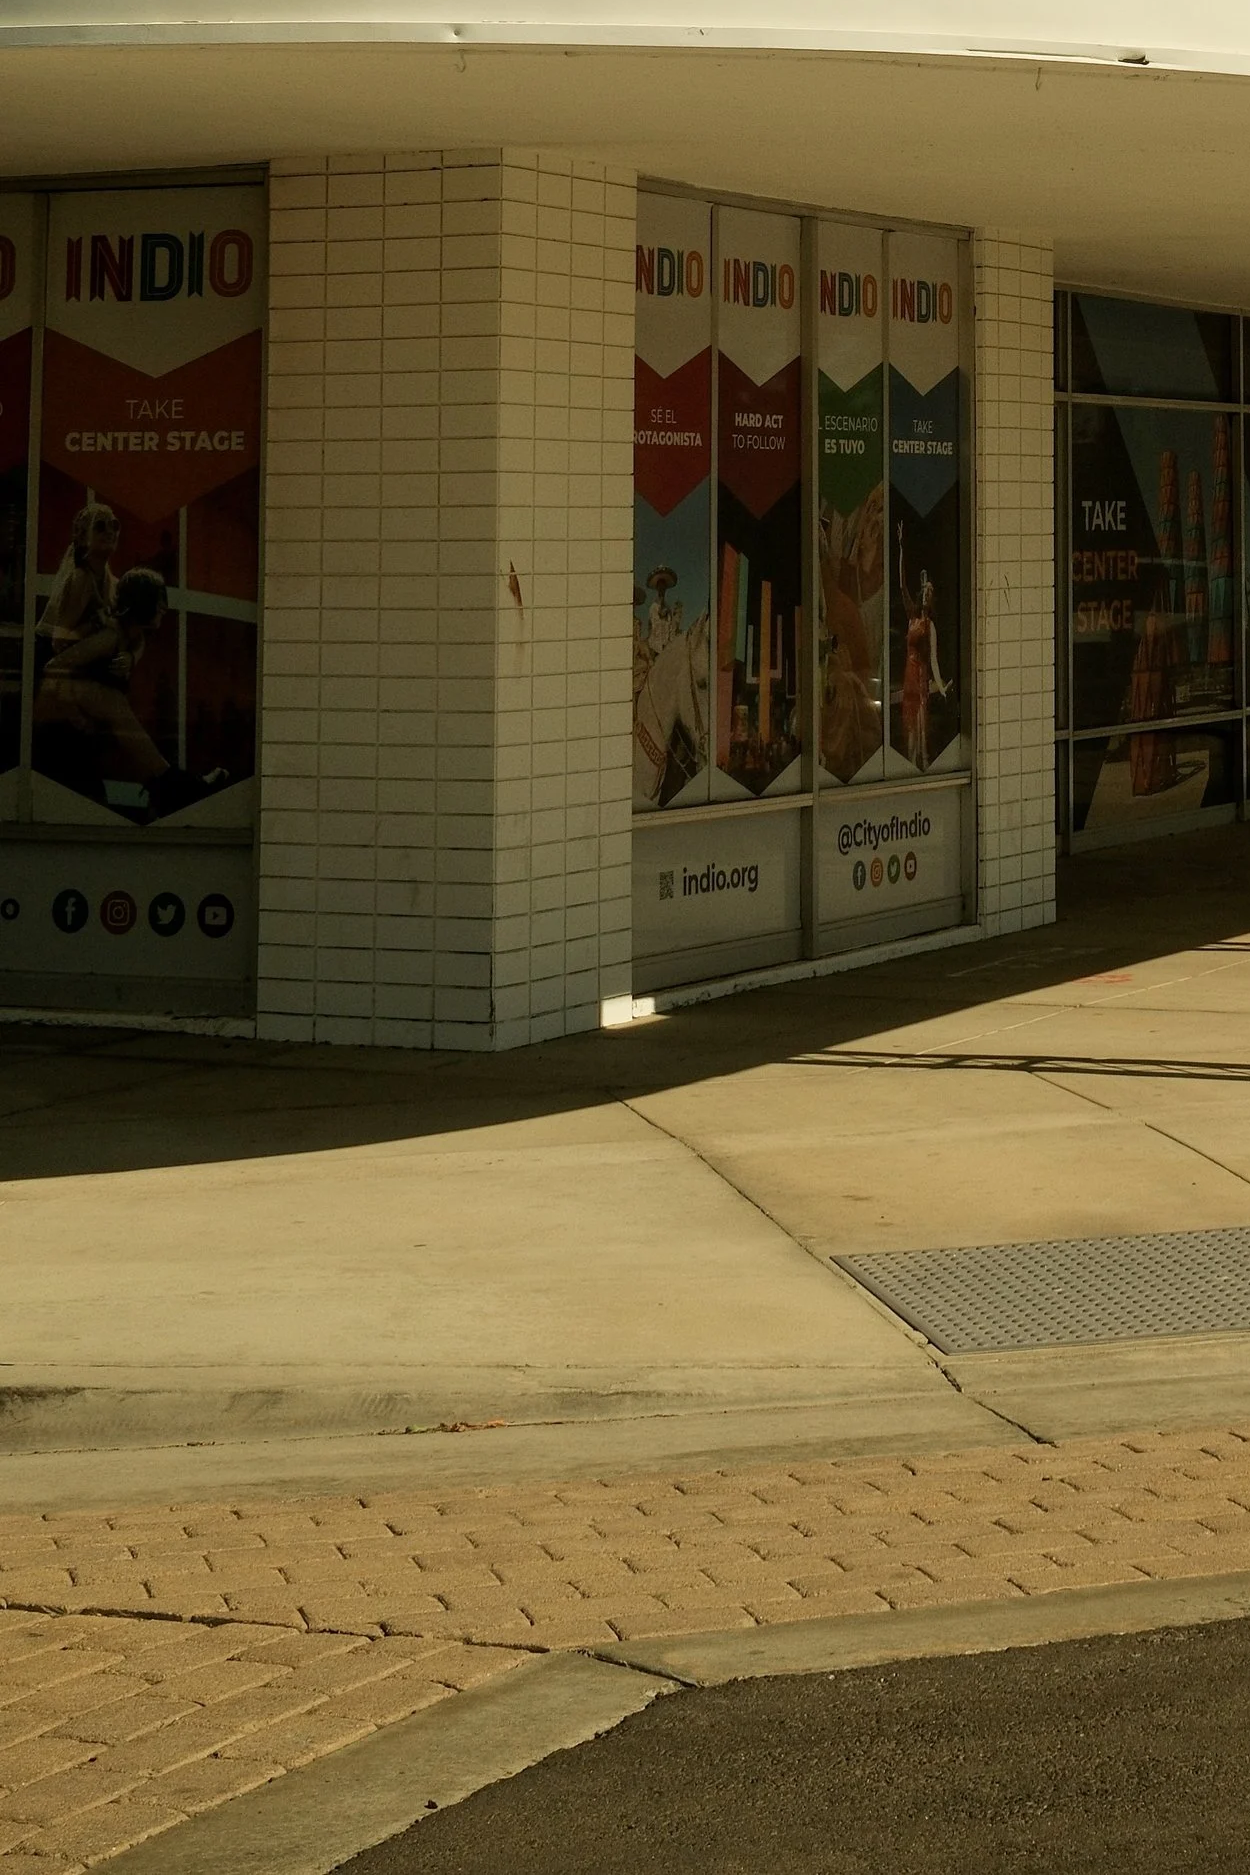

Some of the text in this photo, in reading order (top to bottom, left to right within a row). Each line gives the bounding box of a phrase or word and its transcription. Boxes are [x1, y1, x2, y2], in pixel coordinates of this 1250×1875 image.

[66, 229, 254, 302] INDIO
[636, 244, 704, 298] NDIO
[723, 258, 795, 309] INDIO
[820, 269, 878, 318] NDIO
[892, 278, 953, 324] INDIO
[125, 399, 185, 420] TAKE
[650, 406, 677, 424] SÉ EL
[735, 412, 784, 429] HARD ACT
[824, 415, 878, 432] ESCENARIO
[912, 419, 933, 434] TAKE
[64, 430, 245, 452] CENTER STAGE
[634, 430, 703, 447] ROTAGONISTA
[732, 433, 786, 450] TO FOLLOW
[824, 439, 865, 455] ES TUYO
[892, 439, 953, 455] CENTER STAGE
[1081, 500, 1127, 531] TAKE
[1072, 549, 1139, 582] CENTER
[1077, 599, 1133, 633] STAGE
[838, 811, 931, 856] @CityofIndio
[683, 863, 759, 896] indio.org
